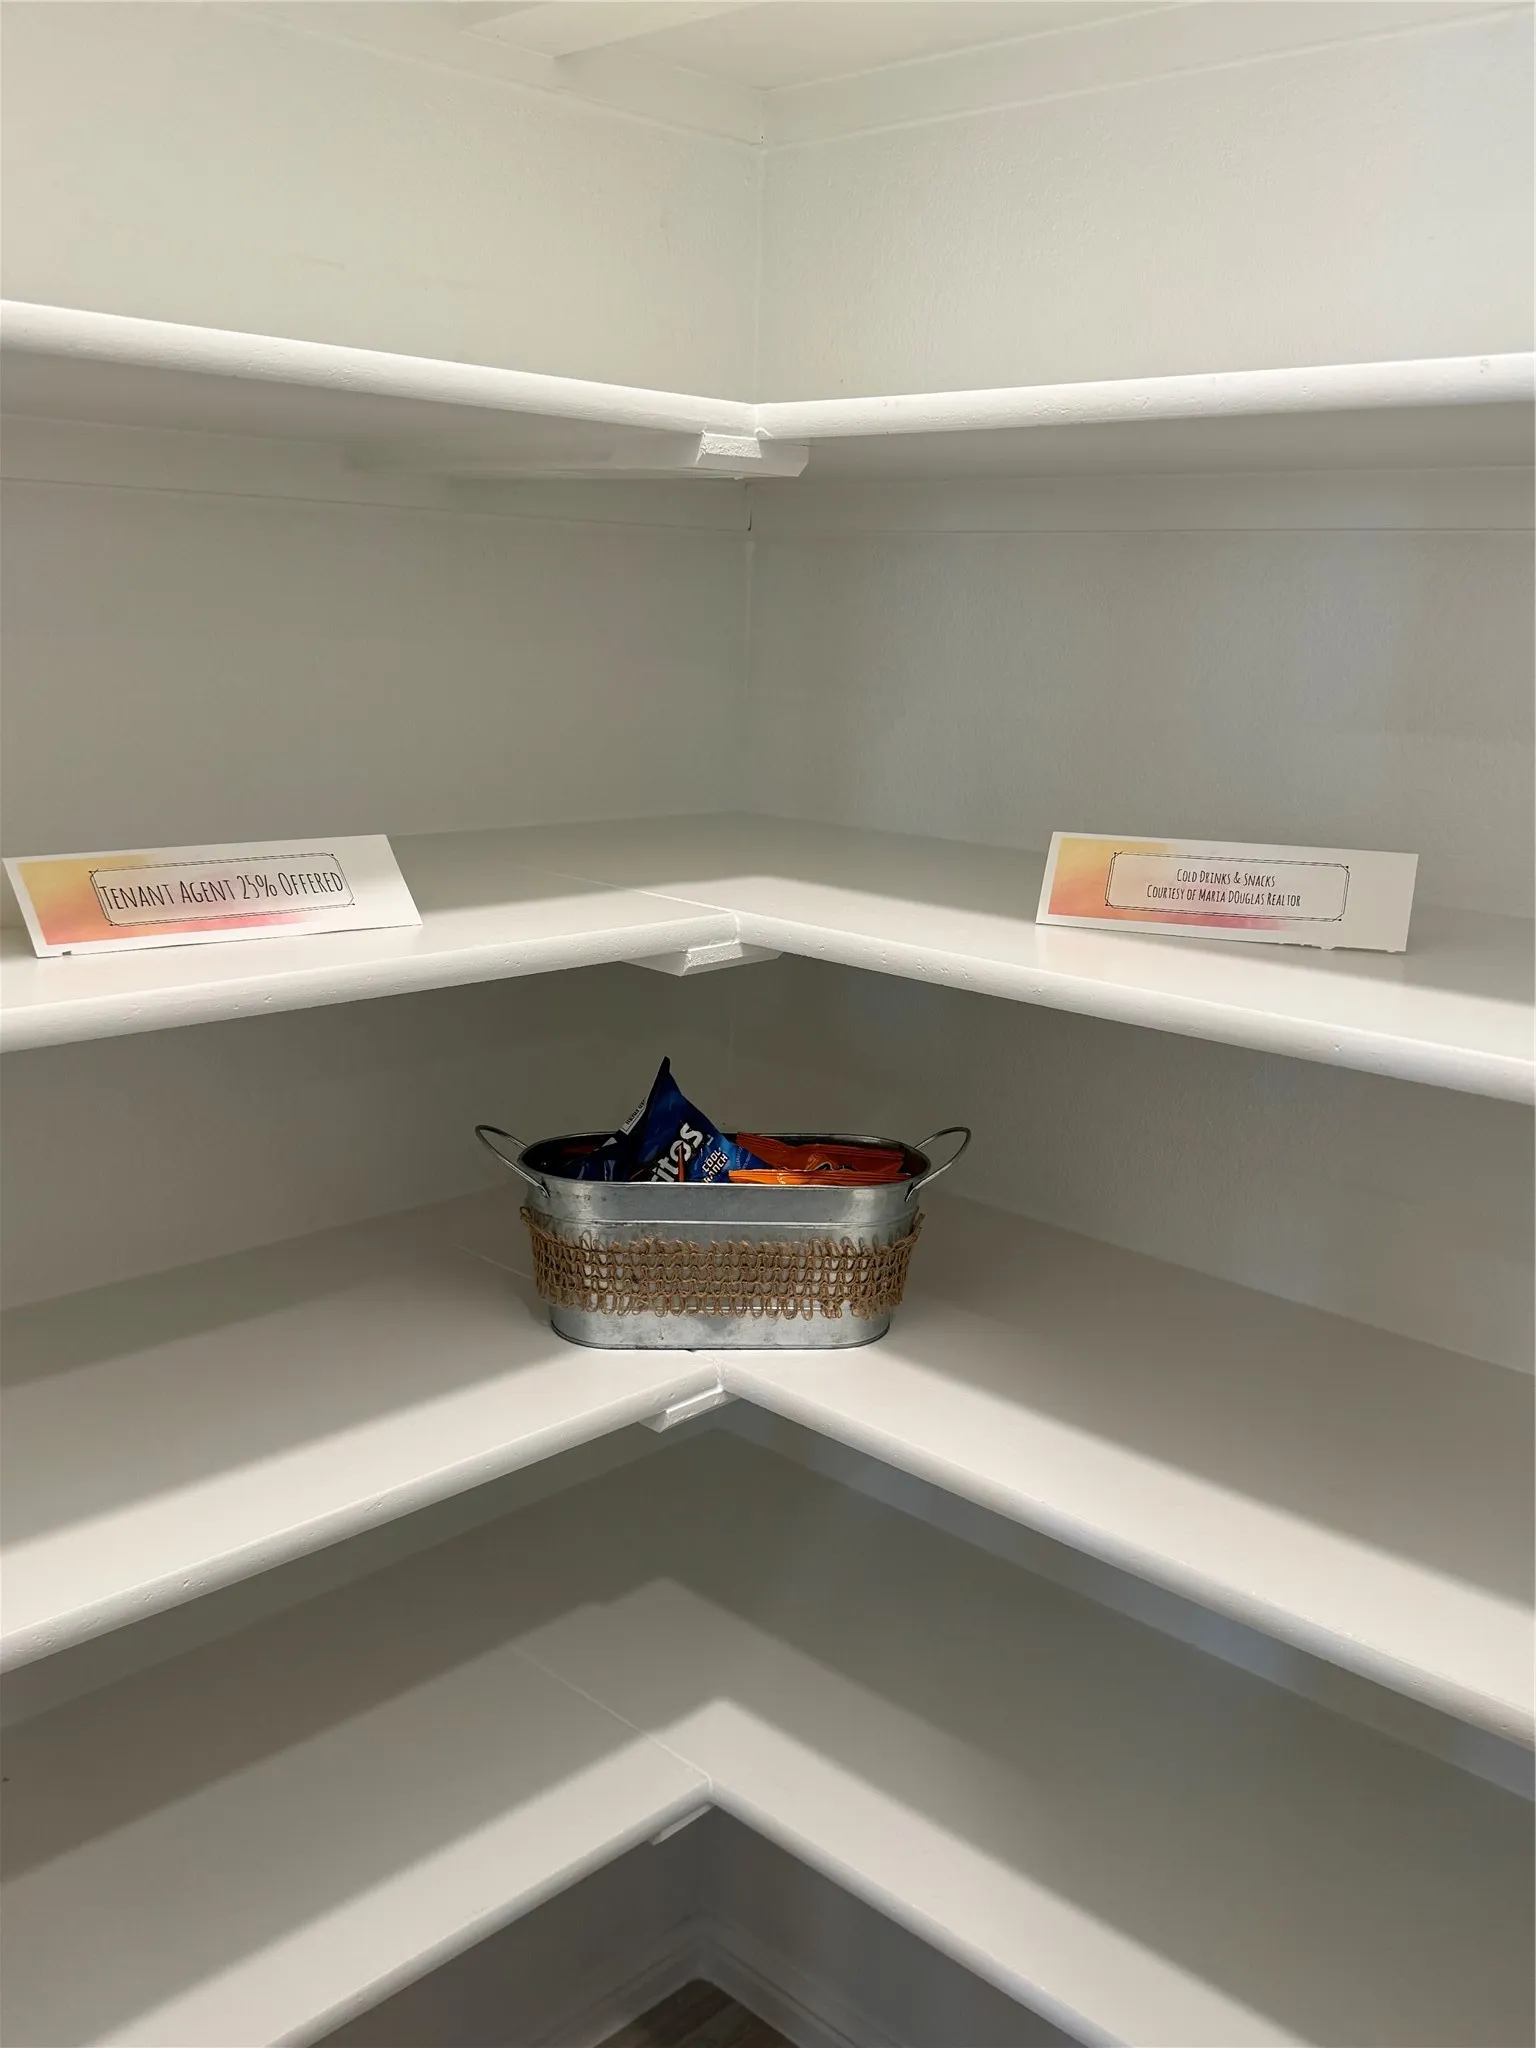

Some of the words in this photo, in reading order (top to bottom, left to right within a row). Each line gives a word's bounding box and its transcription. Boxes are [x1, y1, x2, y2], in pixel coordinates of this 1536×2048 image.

[236, 874, 278, 900] 25%
[1233, 871, 1241, 884] &
[701, 1150, 721, 1172] COOL
